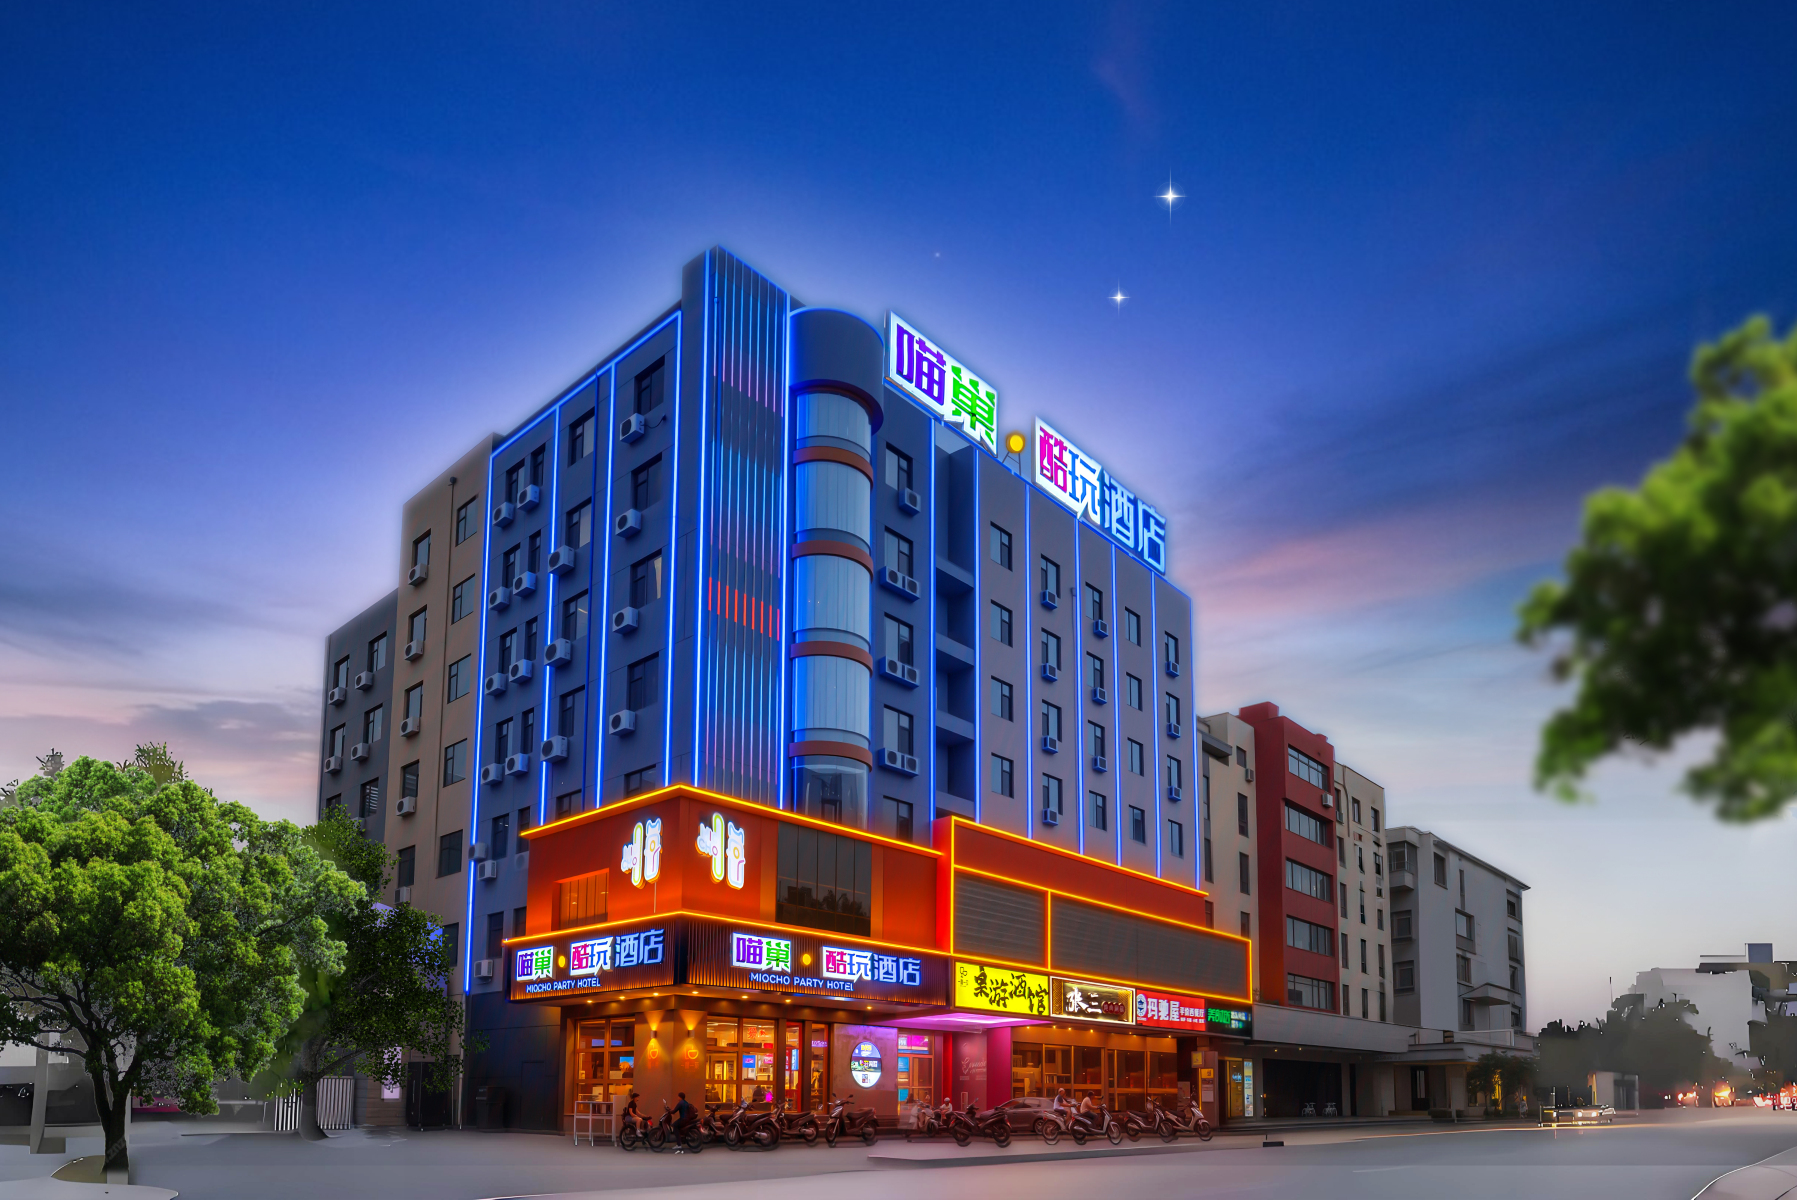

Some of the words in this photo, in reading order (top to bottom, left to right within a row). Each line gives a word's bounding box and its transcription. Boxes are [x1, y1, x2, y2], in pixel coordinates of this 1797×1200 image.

[896, 322, 995, 445] 喵巢
[1039, 425, 1167, 570] 酷玩酒店
[518, 948, 551, 977] 喵巢
[572, 929, 664, 970] 酷玩酒店
[736, 937, 790, 970] 喵巢
[825, 950, 921, 986] 酷玩酒店
[526, 983, 552, 993] MIOCHO
[553, 980, 575, 991] PARTY
[577, 977, 601, 988] HOTEL
[749, 972, 791, 985] MIOCHO
[793, 976, 825, 989] PARTY
[826, 980, 855, 992] HOTEL
